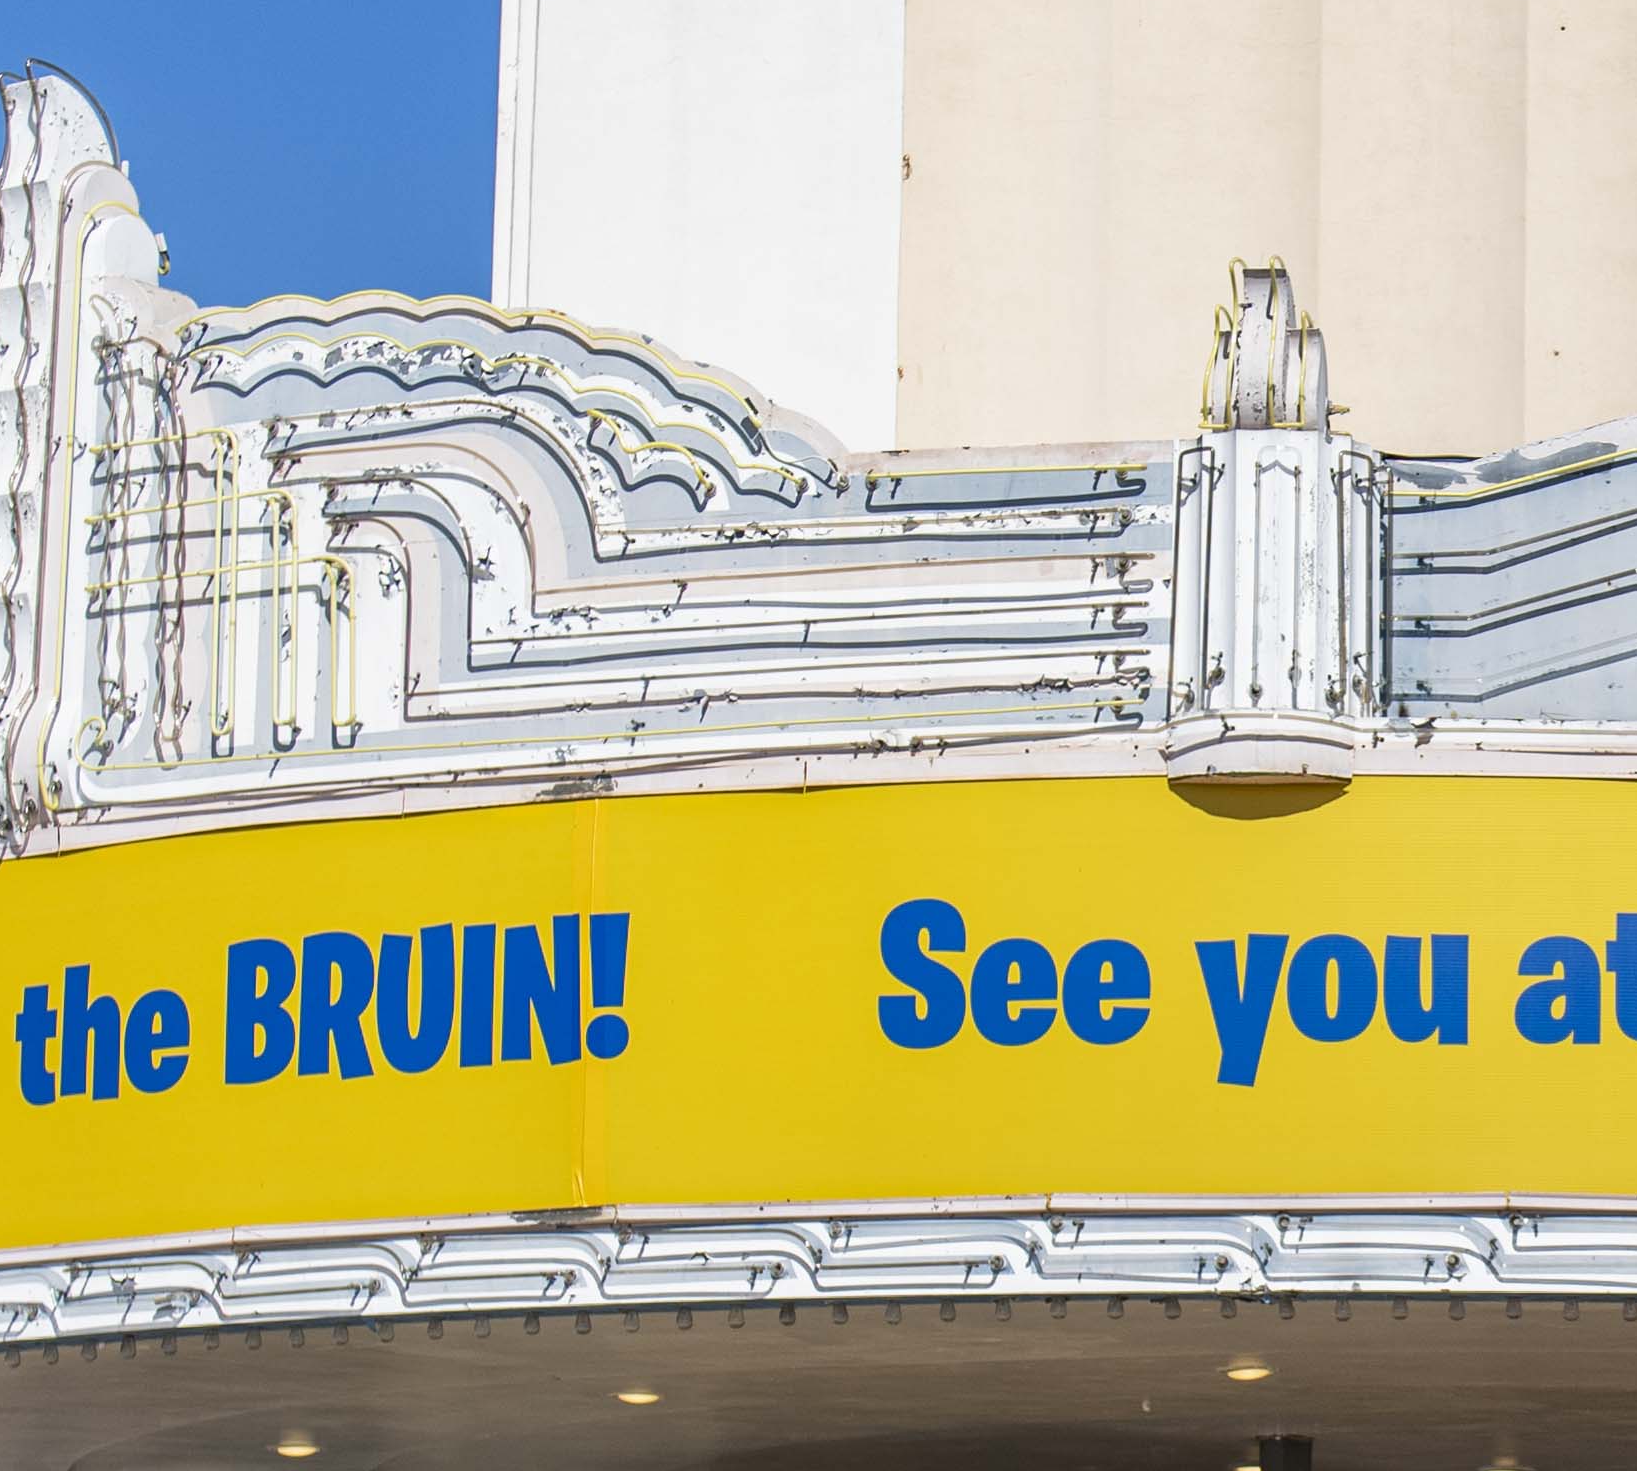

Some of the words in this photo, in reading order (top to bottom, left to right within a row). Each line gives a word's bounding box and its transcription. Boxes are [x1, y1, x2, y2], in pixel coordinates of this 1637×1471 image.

[15, 964, 190, 1106] the
[224, 912, 631, 1085] BRUIN!
[877, 898, 1151, 1049] See
[1194, 933, 1470, 1088] you
